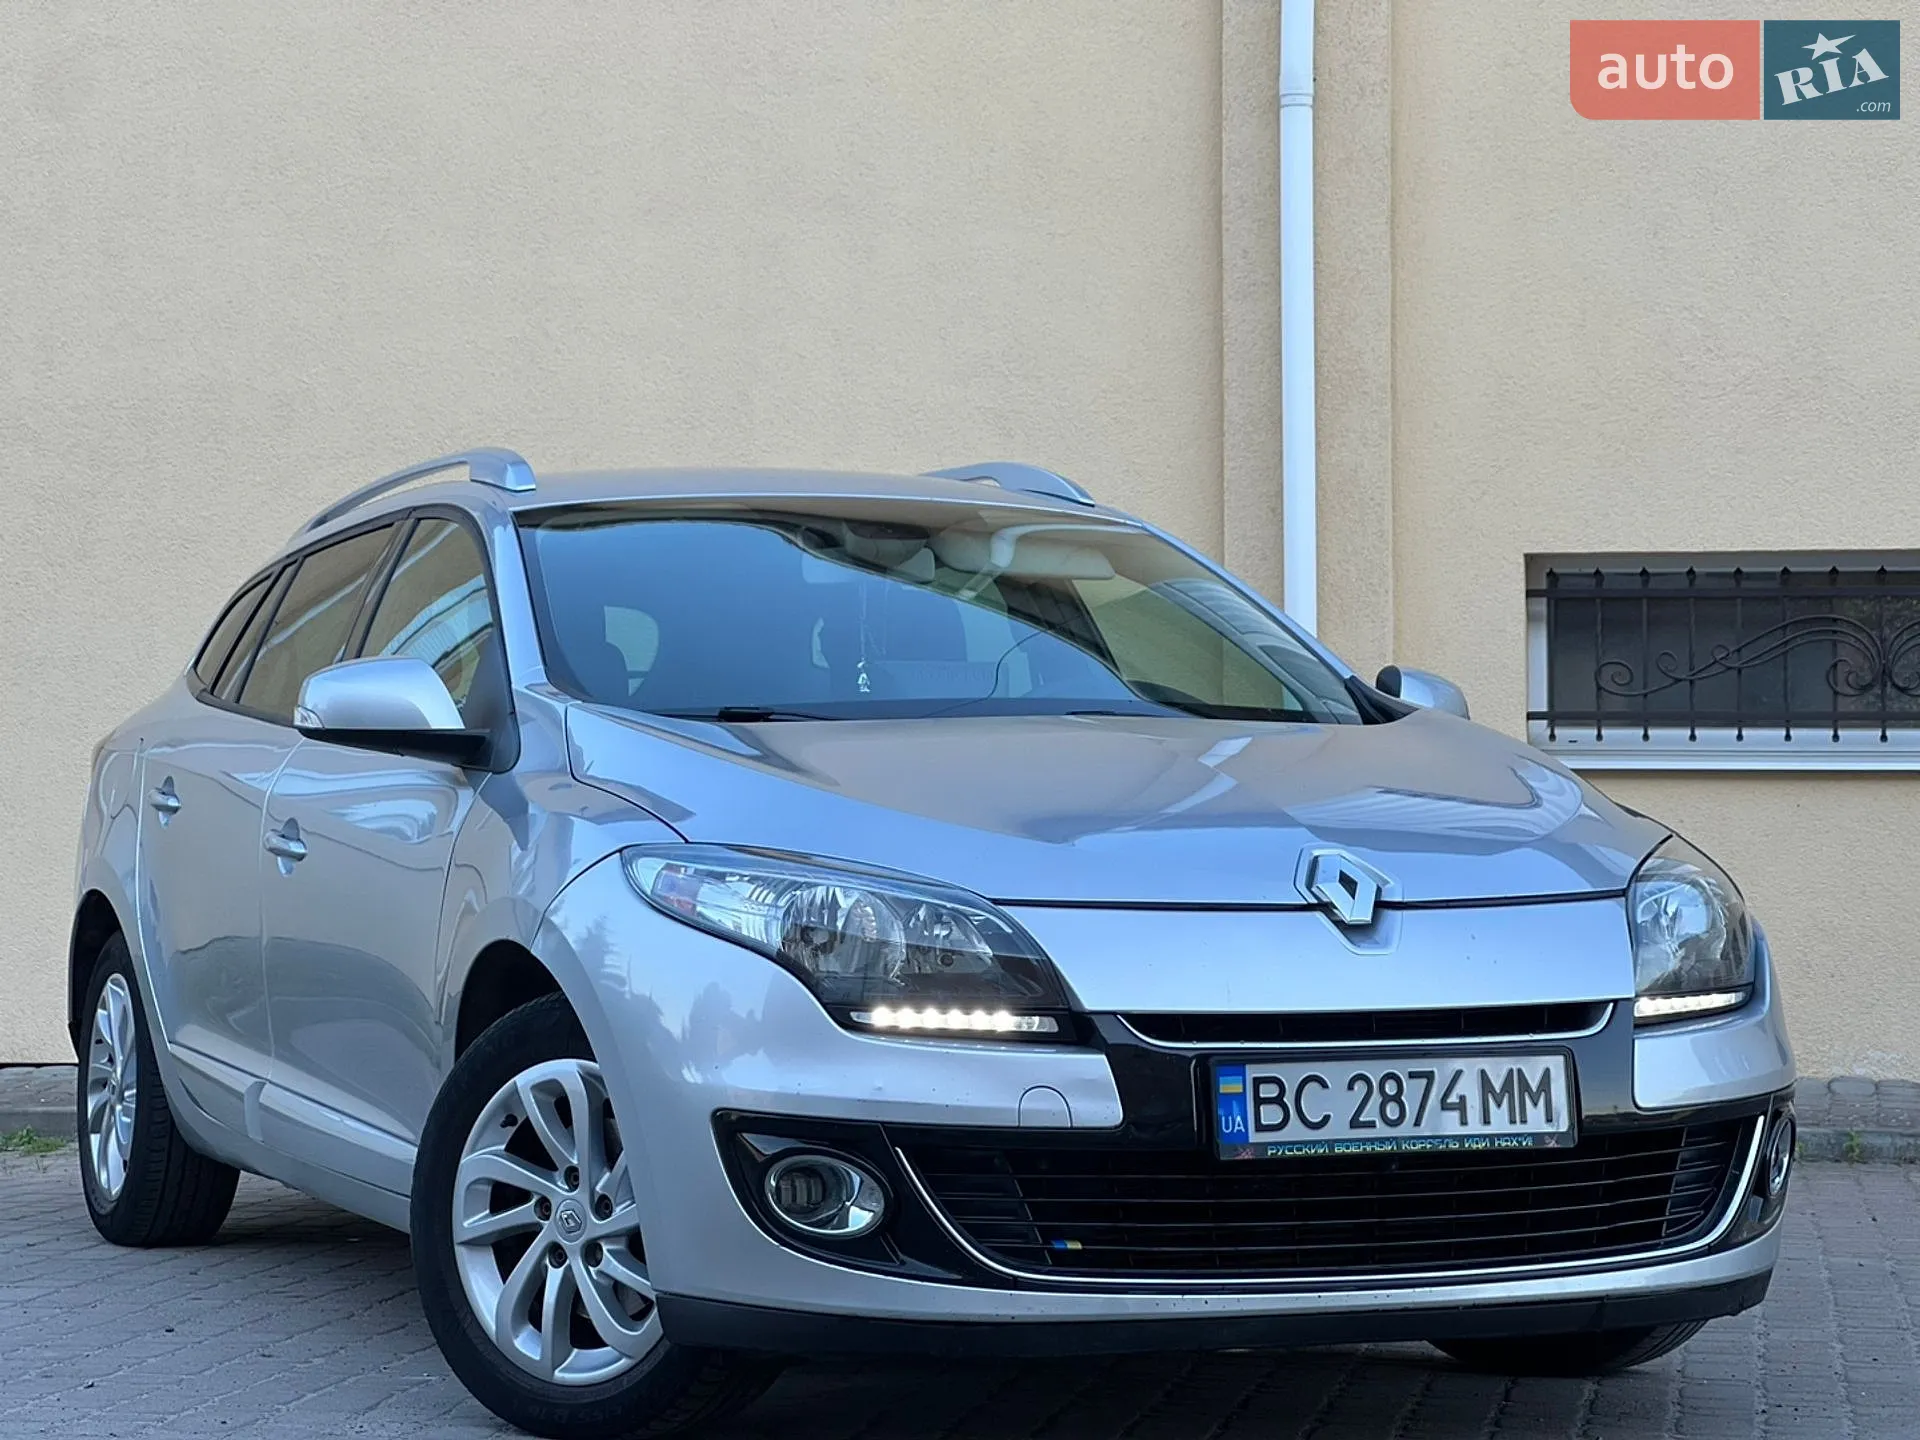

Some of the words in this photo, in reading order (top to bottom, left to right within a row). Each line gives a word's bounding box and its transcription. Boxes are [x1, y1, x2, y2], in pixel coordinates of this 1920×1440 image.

[1253, 1074, 1331, 1132] BC
[1347, 1069, 1469, 1129] 2874
[1480, 1066, 1554, 1125] MM
[1222, 1115, 1246, 1134] UA
[1267, 1140, 1329, 1156] РУССКИЙ
[1334, 1138, 1398, 1152] ВОЕННЫЙ
[1464, 1136, 1490, 1149] ИДИ
